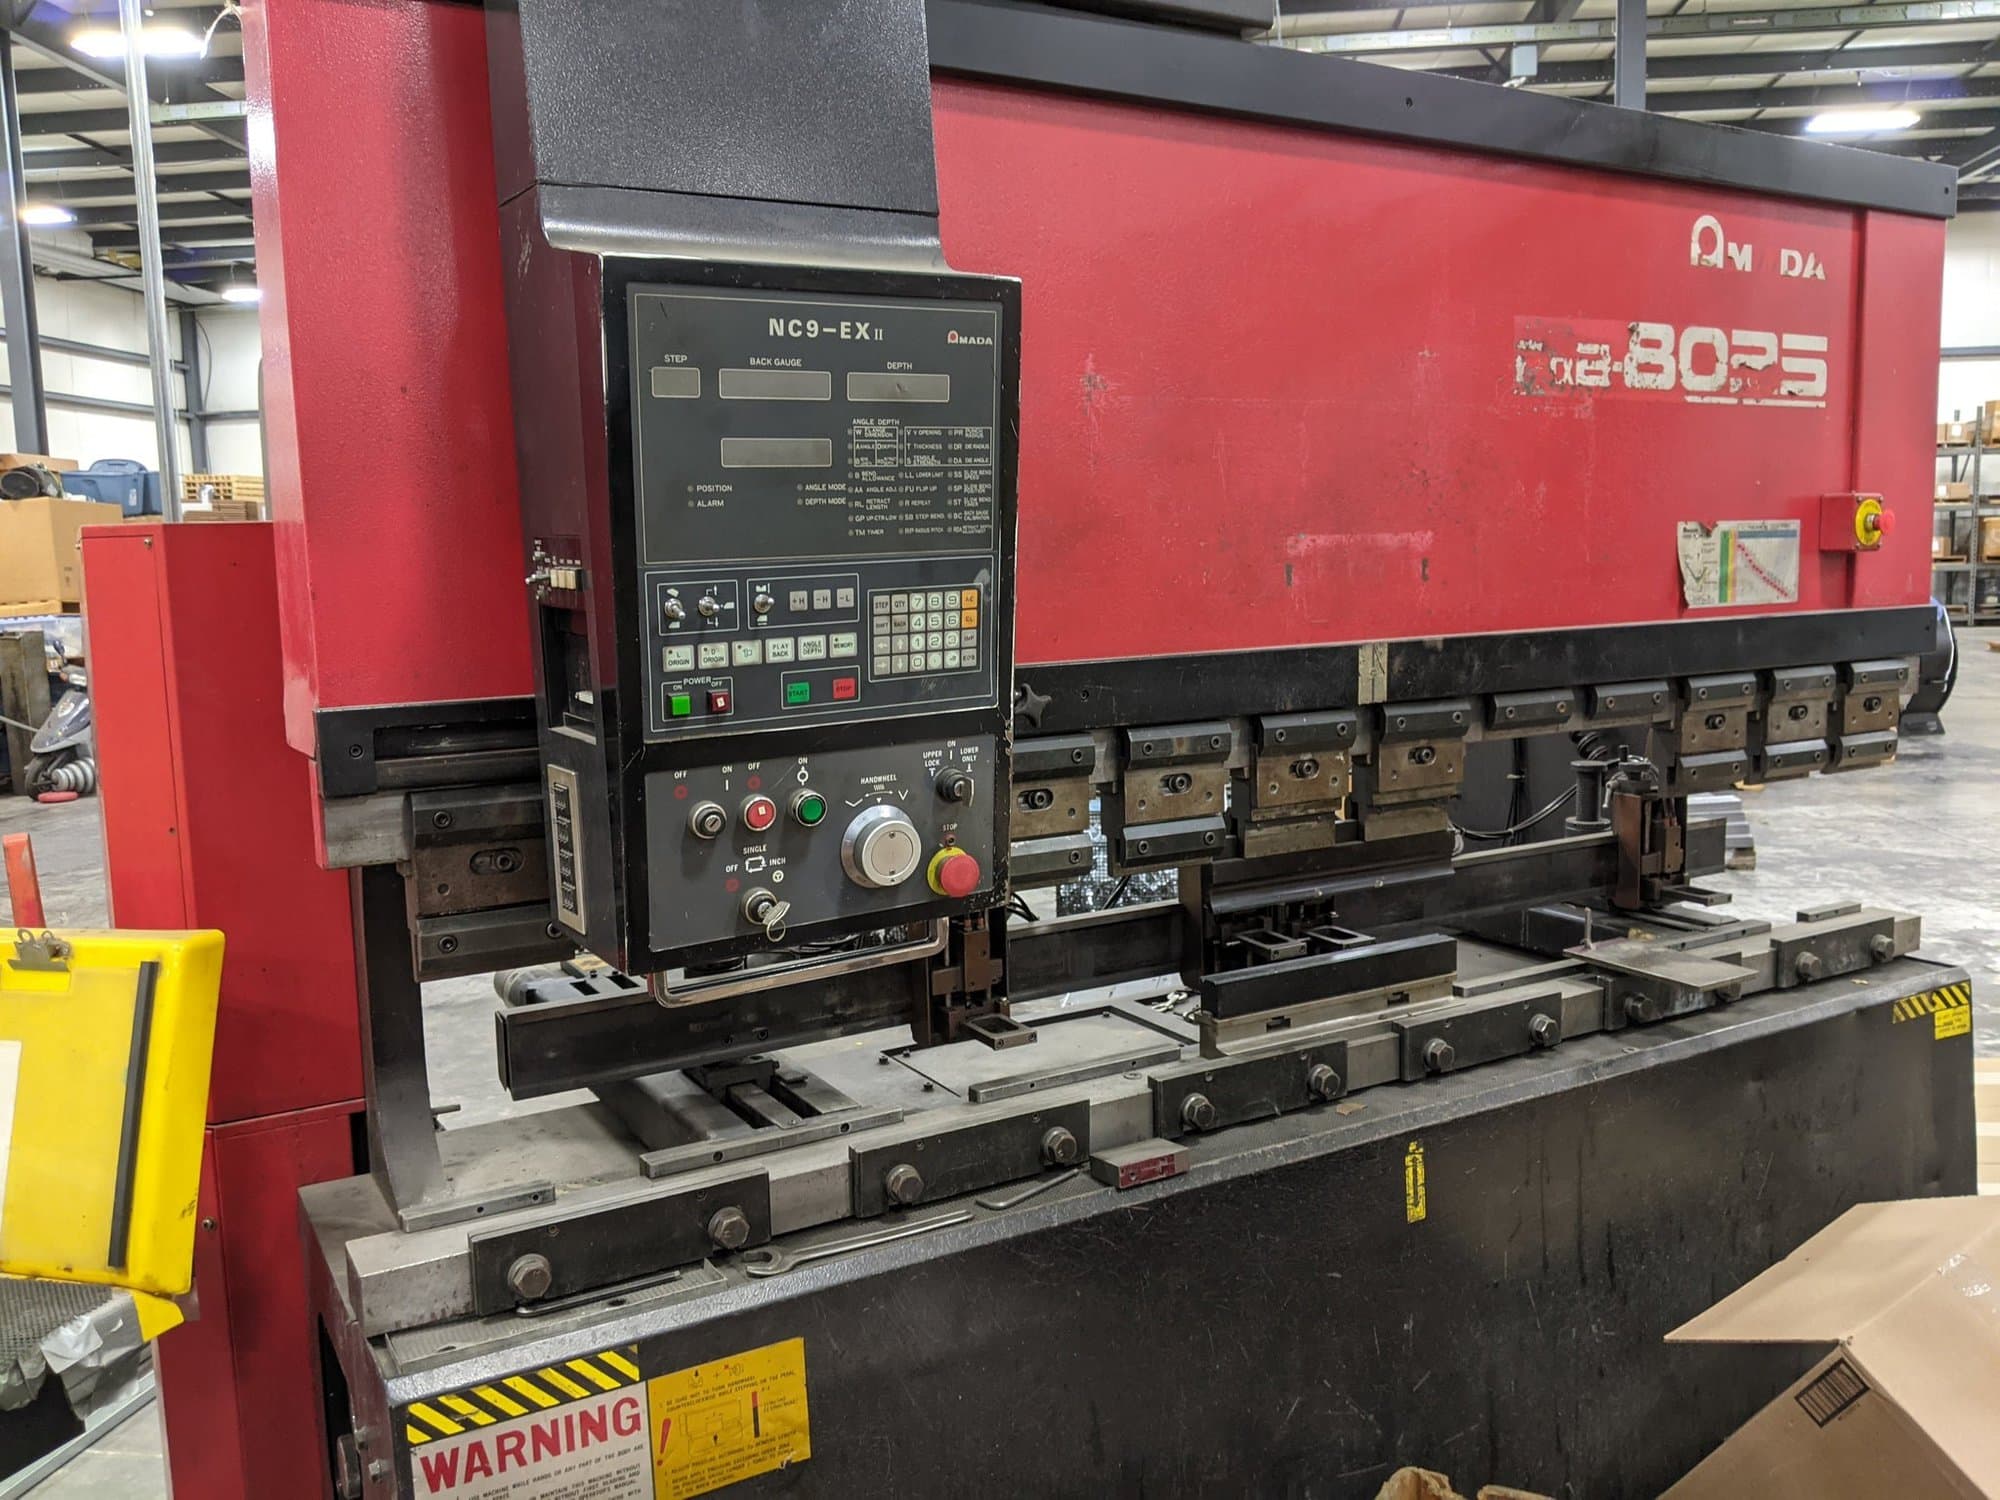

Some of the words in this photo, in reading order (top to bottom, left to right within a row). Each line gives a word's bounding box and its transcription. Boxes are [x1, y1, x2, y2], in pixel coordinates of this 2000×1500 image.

[947, 330, 993, 345] AMADA
[664, 354, 687, 363] STEP
[750, 357, 773, 367] BACK
[774, 358, 802, 367] GAUGE
[887, 362, 913, 371] DEPTH
[852, 418, 875, 426] ANGLE
[877, 418, 900, 426] DEPTH
[696, 485, 733, 493] POSITION
[805, 483, 827, 491] ANGLE
[828, 483, 847, 491] MODE
[696, 499, 724, 508] ALARM
[805, 498, 827, 506] DEPTH
[828, 497, 847, 505] MODE
[894, 600, 906, 608] QTY
[914, 597, 922, 607] 7
[930, 596, 940, 606] 8
[948, 595, 958, 605] 9
[874, 601, 889, 609] STEP
[913, 617, 922, 627] 4
[930, 617, 940, 626] 5
[948, 615, 957, 625] 6
[802, 640, 821, 648] ANGLE
[930, 636, 940, 646] 2
[948, 635, 957, 645] 3
[833, 641, 853, 649] MEMORY
[802, 646, 822, 655] DEPTH
[667, 658, 690, 666] ORIGIN
[703, 655, 725, 664] ORIGIN
[913, 656, 922, 667] 0
[683, 676, 712, 686] POWER
[788, 689, 808, 697] START
[947, 740, 957, 748] ON
[923, 749, 942, 759] UPPER
[960, 746, 979, 755] LOWER
[798, 757, 808, 765] ON
[962, 754, 978, 763] ONLY
[748, 762, 760, 771] OFF
[924, 759, 941, 768] LOCK
[674, 770, 688, 779] OFF
[722, 766, 733, 774] ON
[860, 774, 897, 785] HANDWHEEL
[942, 823, 958, 832] STOP
[743, 844, 767, 855] SINGLE
[769, 856, 786, 866] INCH
[725, 864, 739, 873] OFF
[420, 1396, 642, 1495] WARNING
[483, 1485, 509, 1497] MACHINE
[512, 1479, 529, 1489] WHILE
[565, 1465, 576, 1473] ANY
[578, 1459, 593, 1468] PART
[605, 1452, 615, 1460] THE
[617, 1448, 631, 1457] BODY
[634, 1443, 644, 1451] ARE
[572, 1481, 585, 1489] THIS
[587, 1471, 612, 1484] MACHINE
[615, 1462, 641, 1475] WITHOUT
[602, 1475, 626, 1486] READING
